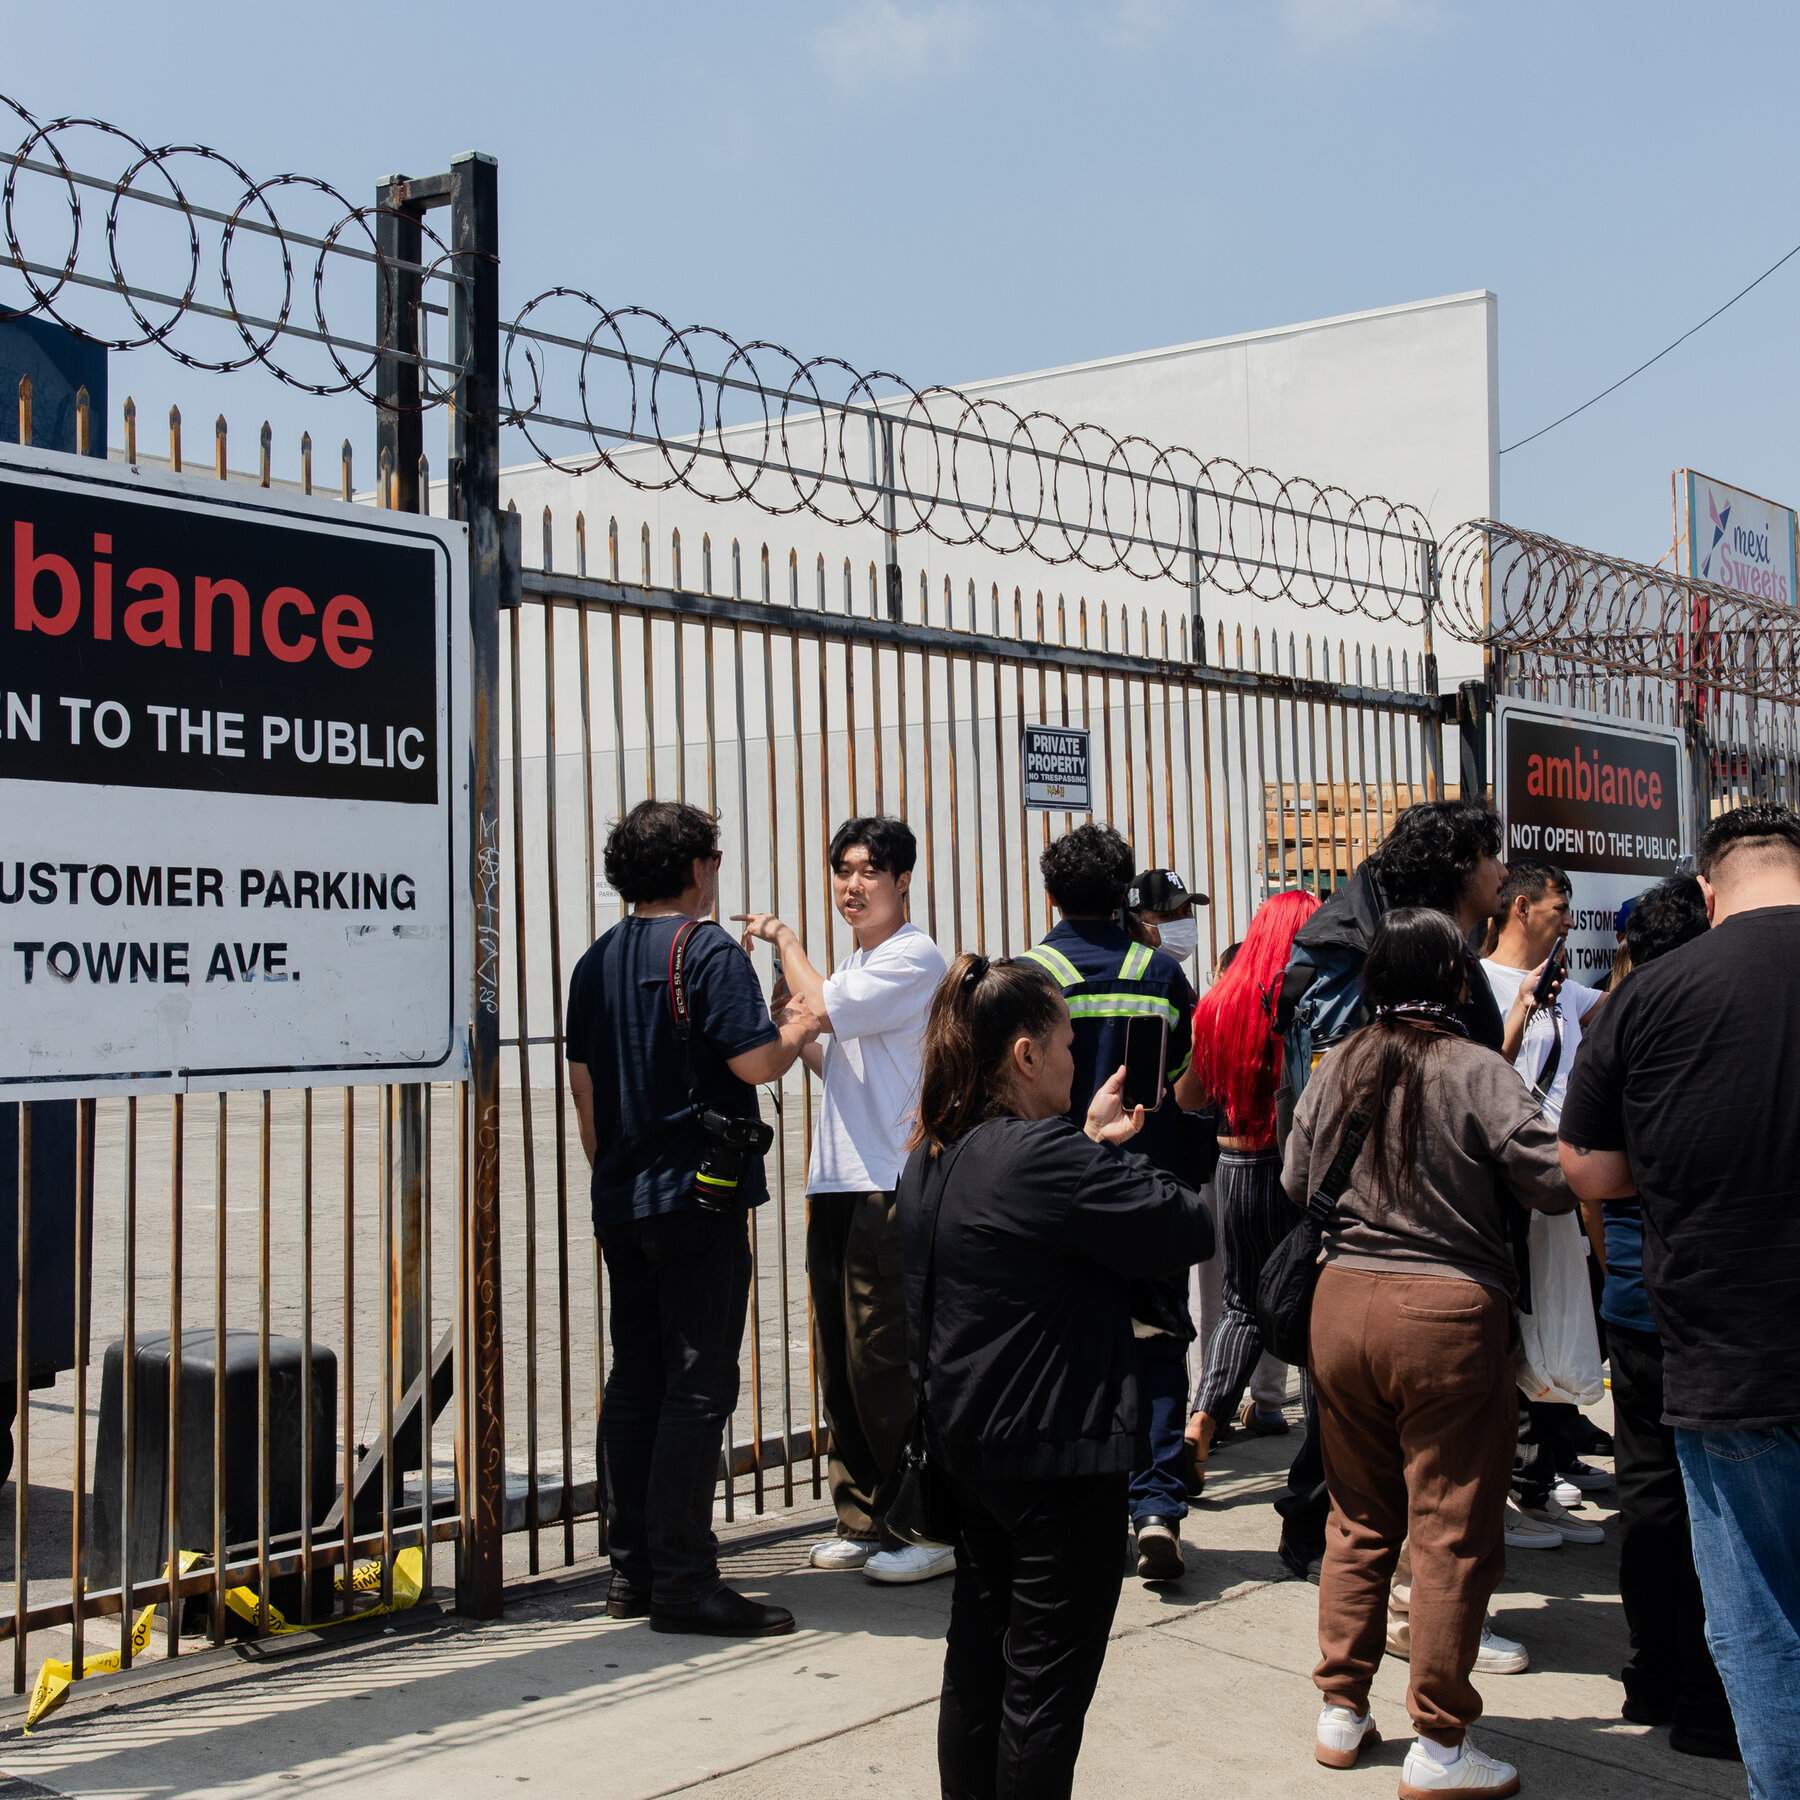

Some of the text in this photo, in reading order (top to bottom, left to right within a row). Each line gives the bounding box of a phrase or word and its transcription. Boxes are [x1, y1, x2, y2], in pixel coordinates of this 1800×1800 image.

[1734, 523, 1770, 564] mexi
[1720, 542, 1787, 604] Sweets
[14, 520, 374, 669] biance
[0, 691, 425, 770] N TO THE PUBLIC
[1033, 734, 1080, 755] PRIVATE
[1028, 753, 1086, 774] PROPERTY
[1041, 774, 1087, 784] TRESPASSING
[1527, 747, 1662, 810] ambiance
[1511, 823, 1677, 861] NOT OPEN TO THE PUBLIC
[0, 861, 416, 911] USTOMER PARKING
[13, 941, 300, 984] TOWNE AVE.
[674, 972, 681, 986] 5D
[675, 987, 685, 1014] EOS
